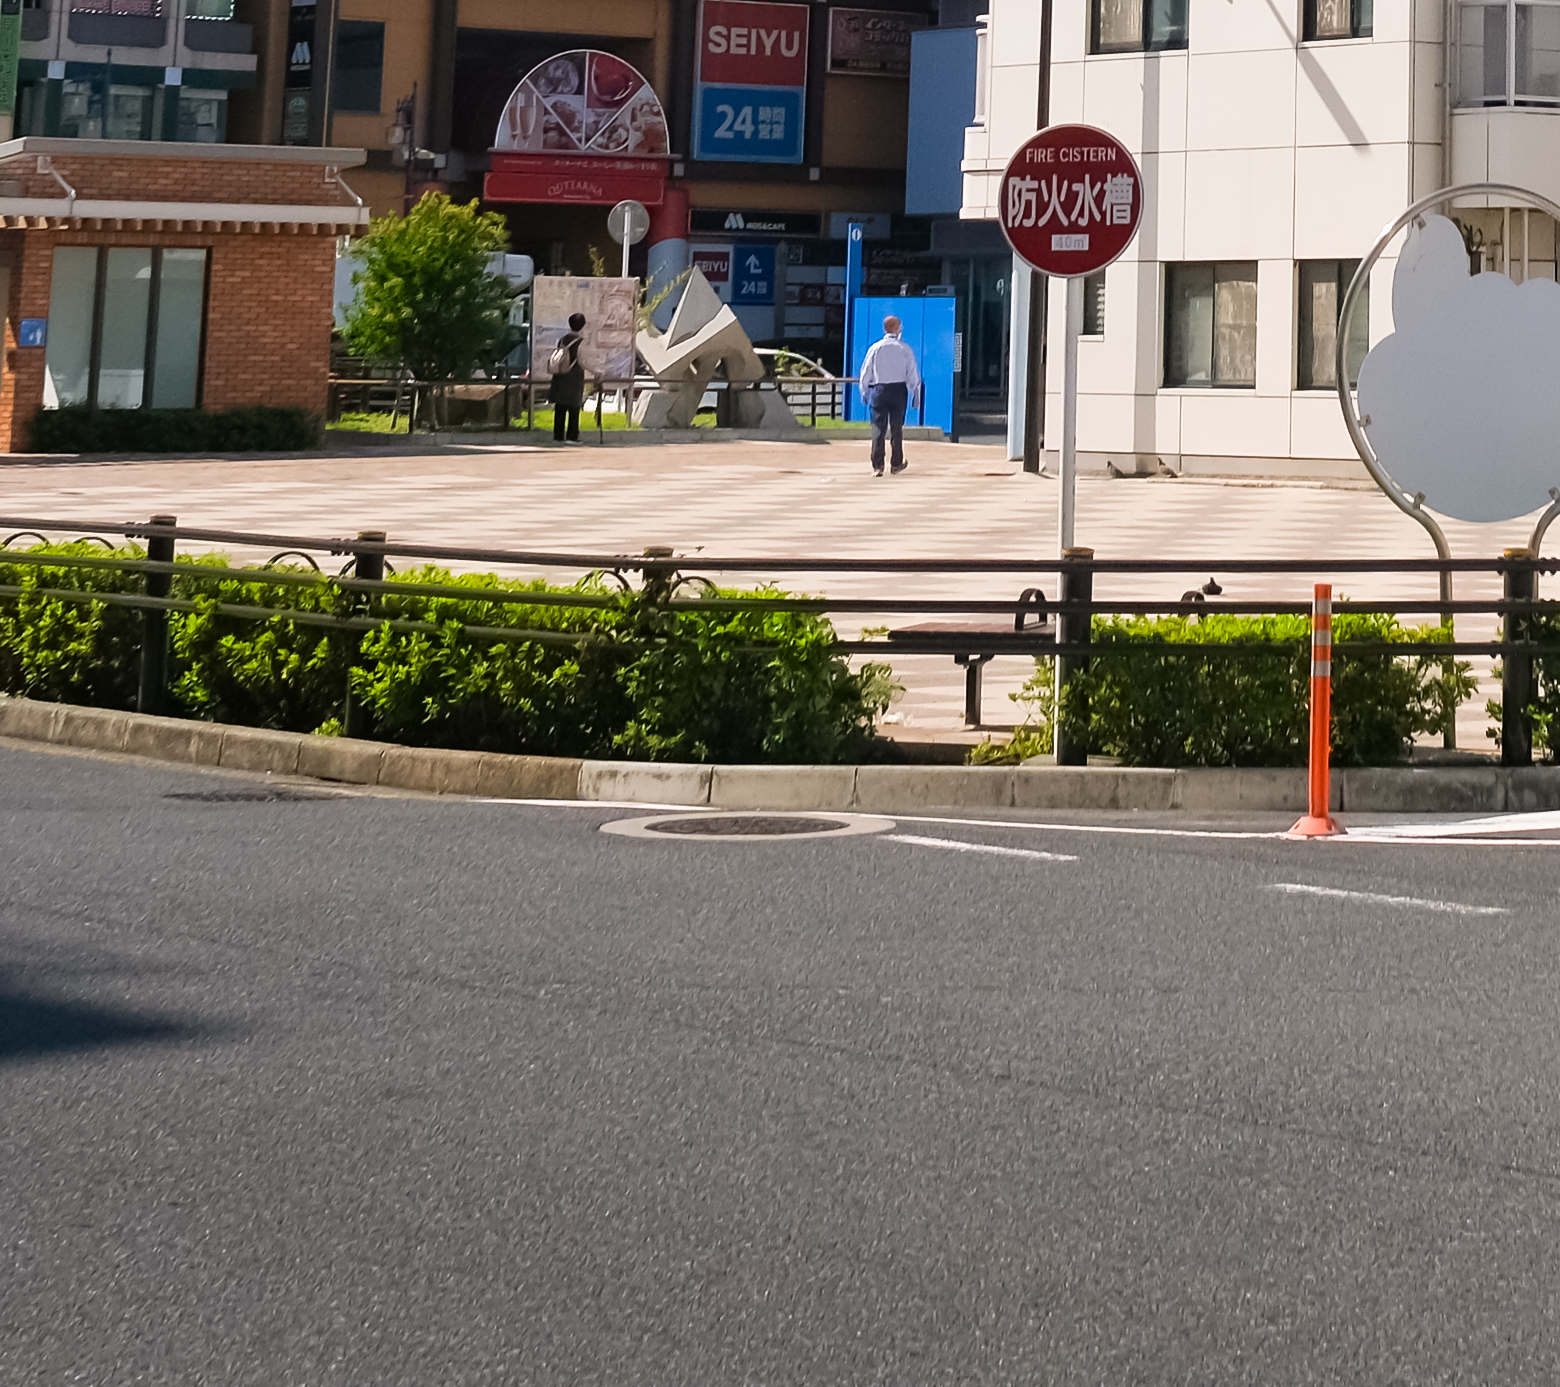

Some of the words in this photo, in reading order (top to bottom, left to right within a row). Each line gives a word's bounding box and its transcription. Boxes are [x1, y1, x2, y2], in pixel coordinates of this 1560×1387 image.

[707, 25, 801, 58] SEIYU
[713, 103, 756, 140] 24
[1025, 147, 1055, 163] FIRE
[1059, 146, 1117, 163] CISTERN
[1007, 172, 1135, 228] 防火水槽
